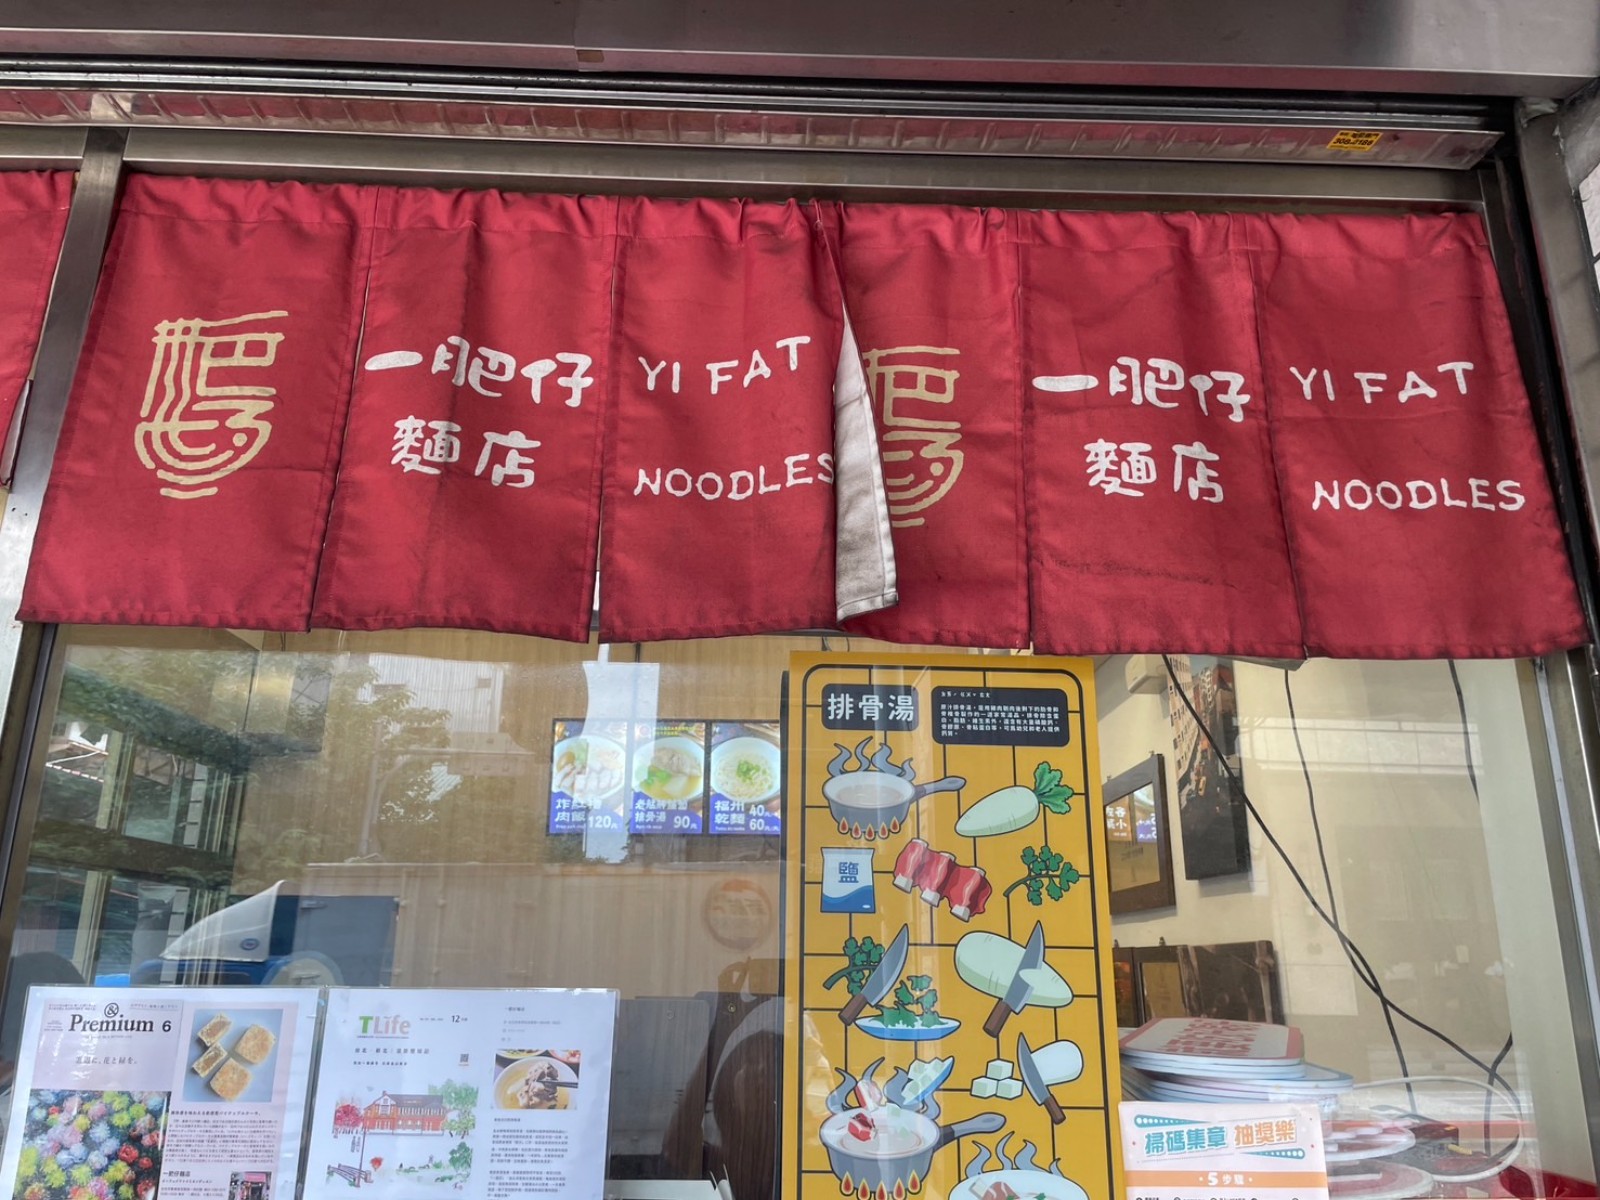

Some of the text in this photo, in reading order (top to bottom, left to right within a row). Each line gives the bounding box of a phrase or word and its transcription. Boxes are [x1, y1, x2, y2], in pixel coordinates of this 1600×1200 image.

[364, 335, 594, 408] 一肥仔
[637, 335, 812, 395] YI FAT
[1289, 361, 1475, 404] YI FAT
[1031, 355, 1251, 423] 一肥仔
[390, 414, 542, 489] 麵店
[1083, 438, 1225, 504] 麵店
[632, 452, 835, 501] NOODLES
[1311, 477, 1526, 512] NOODLES
[827, 693, 915, 722] 排骨湯
[714, 800, 745, 811] 福州
[838, 861, 859, 884] 鹽
[68, 1013, 154, 1032] Premium
[161, 1019, 172, 1033] 6
[1145, 1120, 1297, 1155] 掃碼集章 抽獎樂
[1207, 1171, 1245, 1186] 5 步驟
